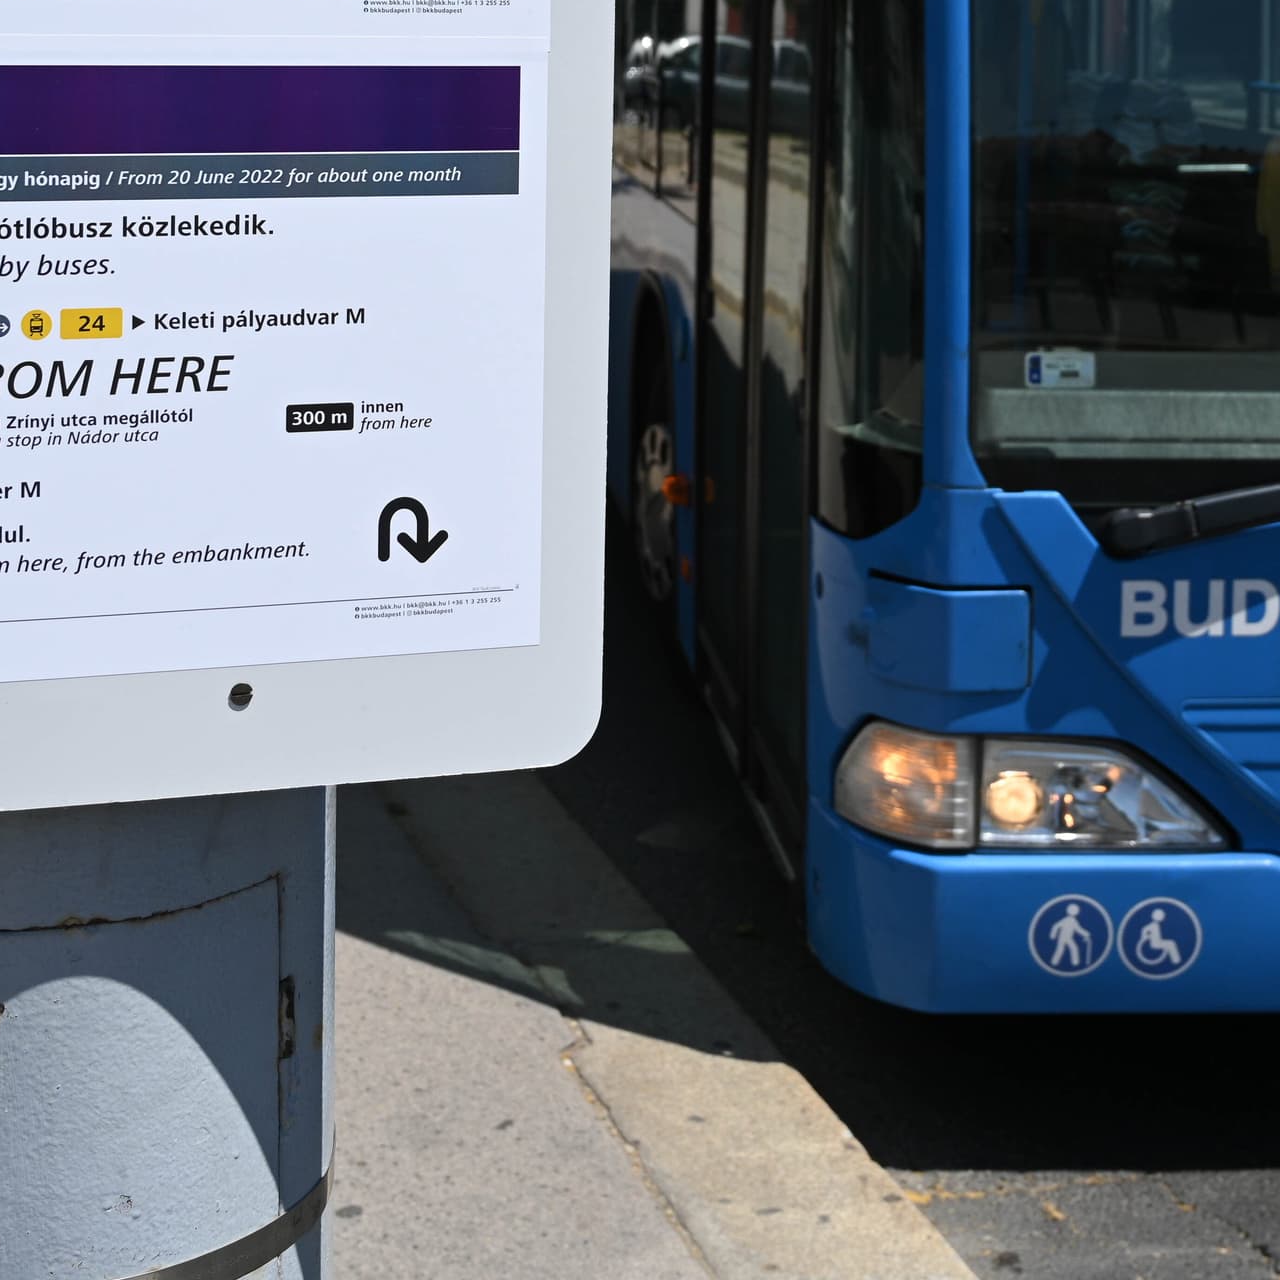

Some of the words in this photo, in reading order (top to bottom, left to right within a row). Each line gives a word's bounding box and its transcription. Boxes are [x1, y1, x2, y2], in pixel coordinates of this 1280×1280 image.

[122, 214, 274, 237] közlekedik.
[79, 315, 105, 332] 24
[155, 311, 214, 330] Keleti
[223, 308, 339, 333] pályaudvar
[346, 308, 365, 324] M
[110, 355, 235, 395] HERE
[6, 414, 54, 432] Zrínyi
[61, 414, 97, 427] utca
[103, 408, 193, 428] megállótól
[292, 411, 325, 426] 300
[331, 413, 347, 424] m
[361, 401, 403, 413] innen
[358, 417, 395, 434] from
[400, 416, 432, 429] here
[21, 481, 40, 498] M
